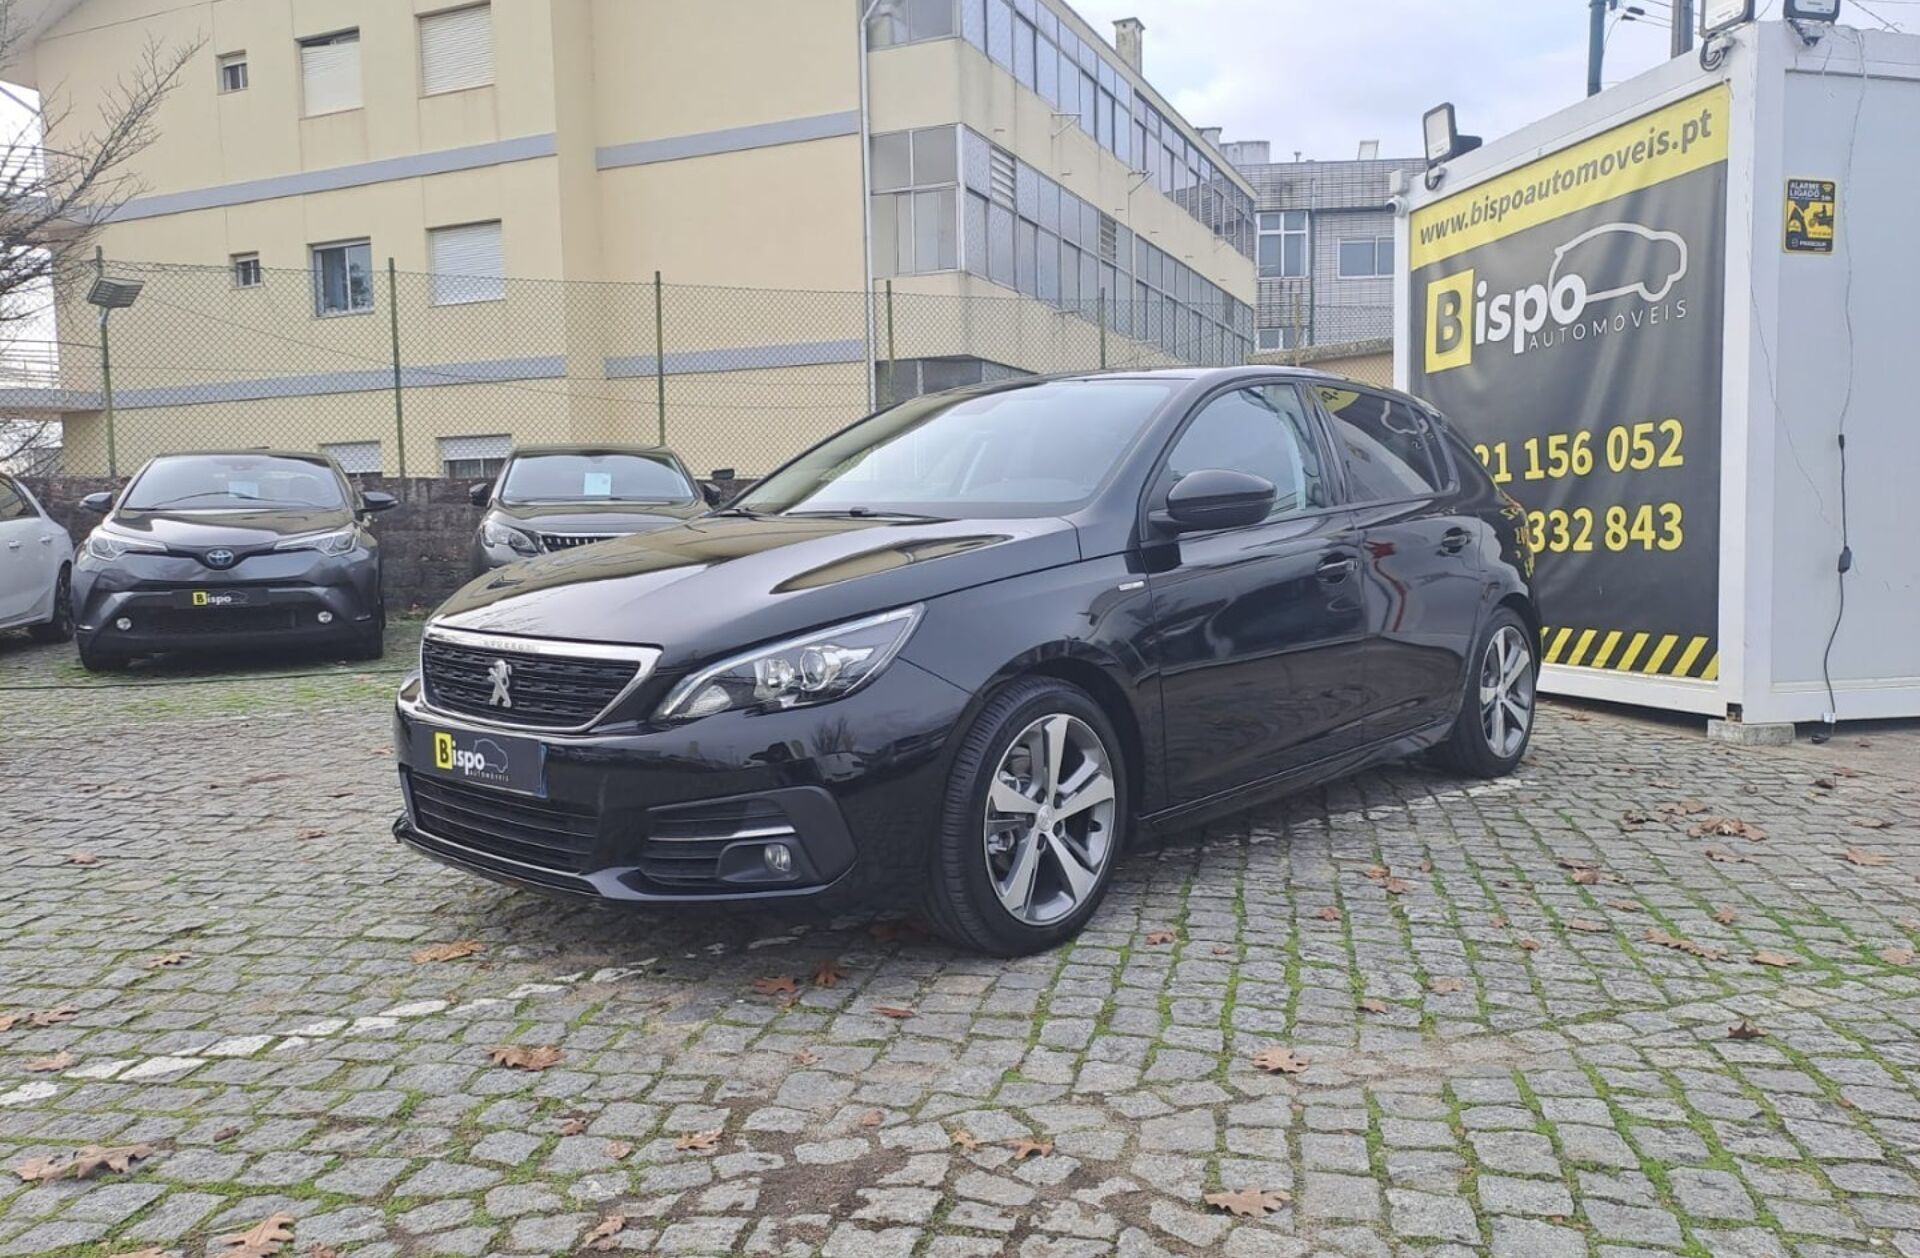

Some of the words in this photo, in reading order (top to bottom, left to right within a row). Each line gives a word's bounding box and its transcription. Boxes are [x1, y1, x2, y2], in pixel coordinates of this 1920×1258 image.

[1419, 108, 1712, 245] www.bispoautomoveis.pt
[1435, 274, 1587, 354] Bispo
[1524, 430, 1593, 480] 156
[1606, 419, 1684, 472] 052
[1605, 502, 1683, 551] 843
[195, 593, 232, 605] Bispo
[439, 738, 485, 775] Bispo
